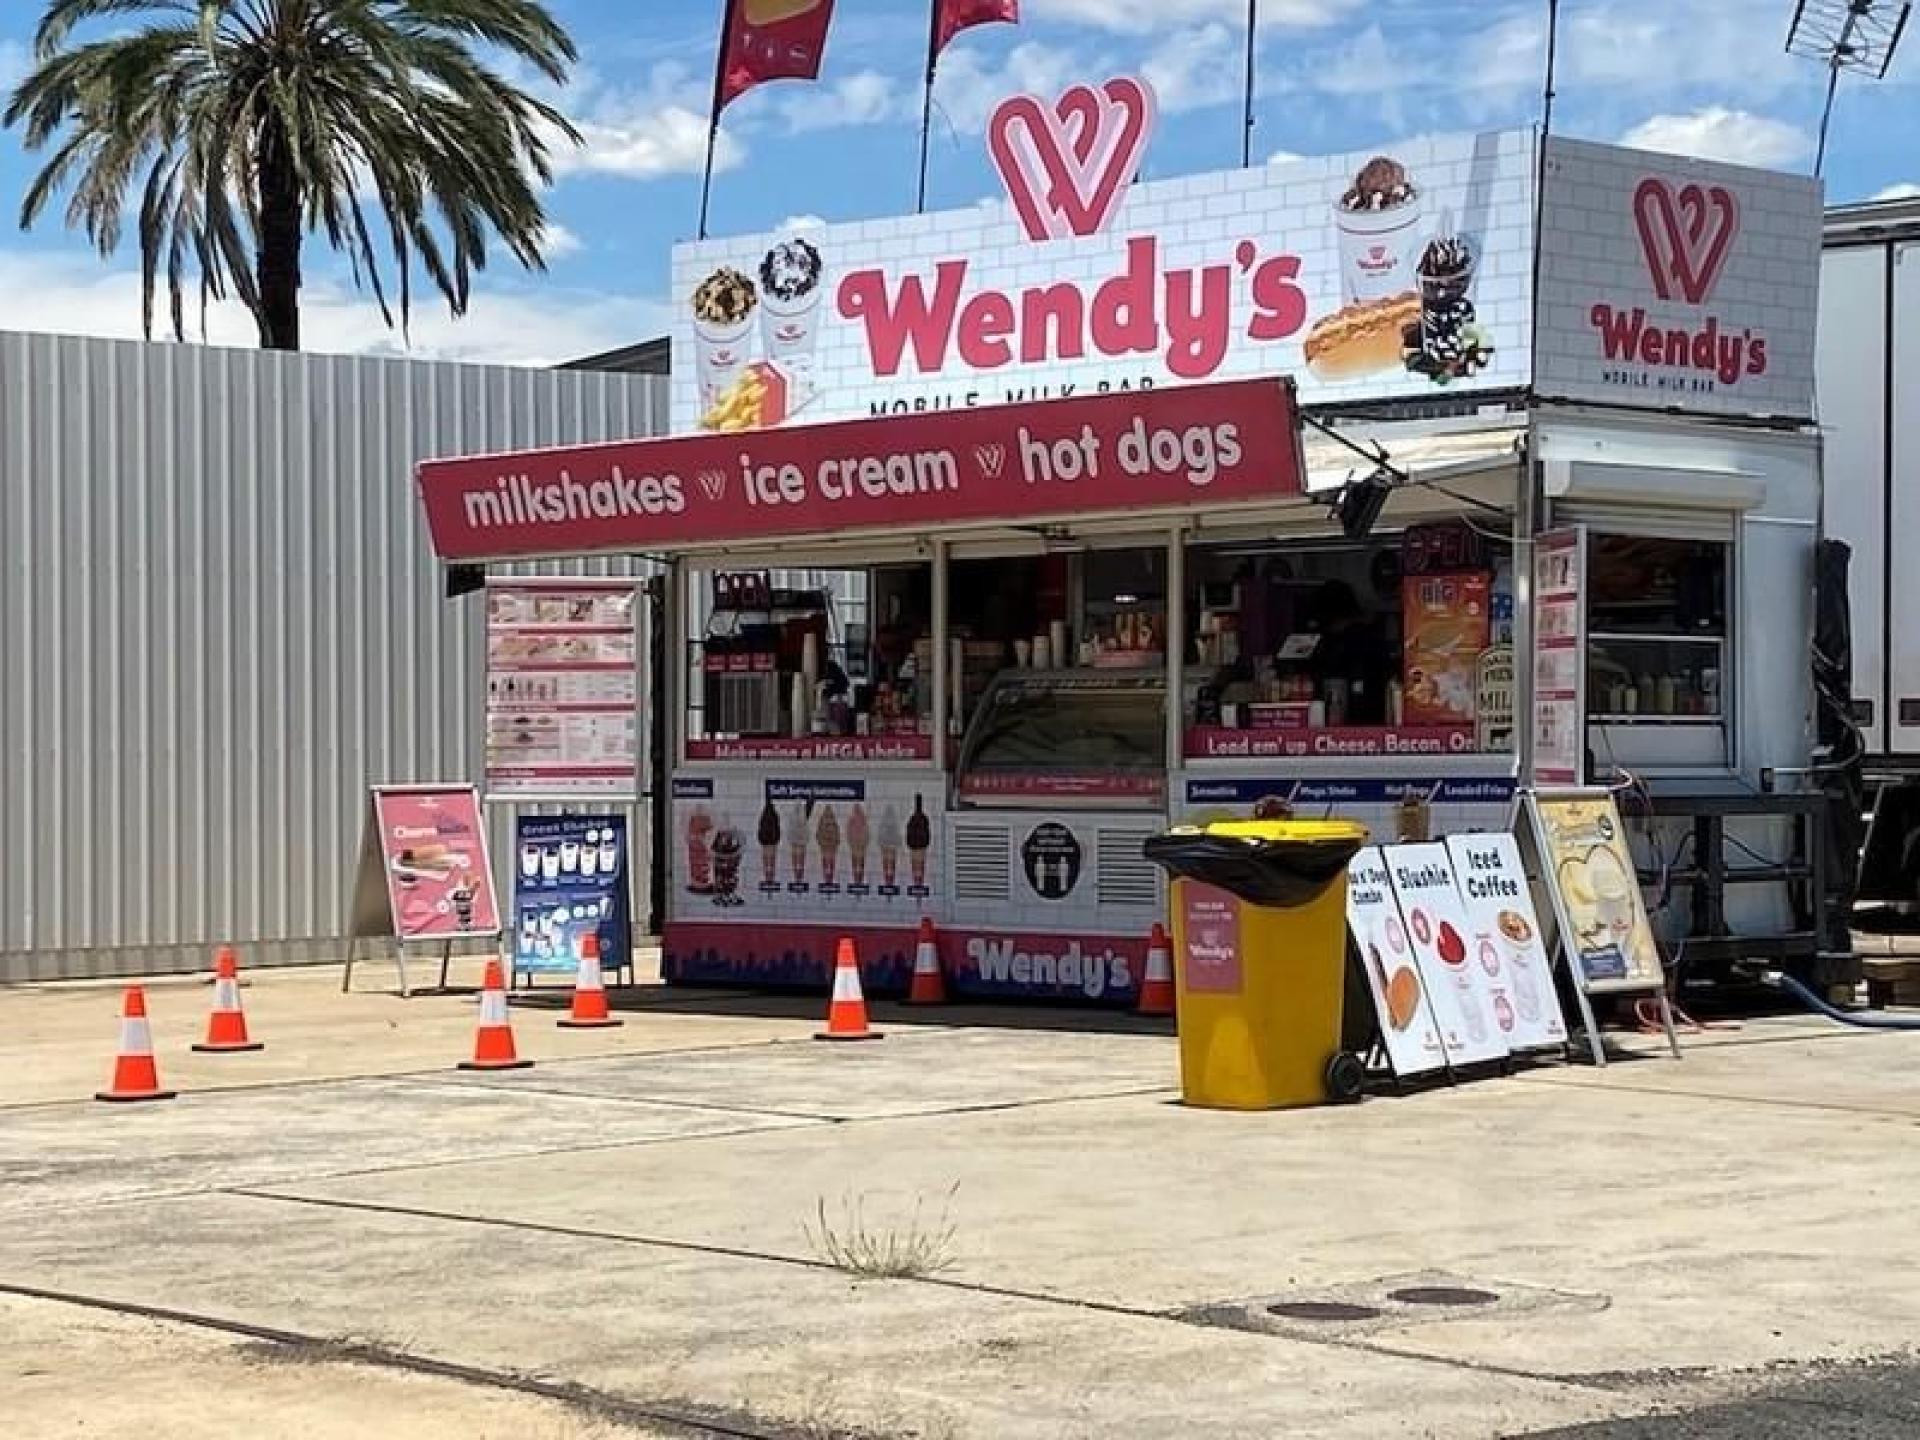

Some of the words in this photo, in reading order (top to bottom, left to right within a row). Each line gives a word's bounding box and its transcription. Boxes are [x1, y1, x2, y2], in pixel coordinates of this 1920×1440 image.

[837, 236, 1307, 378] Wendy's
[1590, 304, 1768, 385] Wendy's
[462, 466, 686, 528] milkshakes
[740, 453, 806, 505] ice
[817, 447, 959, 501] cream
[1018, 423, 1100, 484] hot
[1117, 415, 1242, 485] dogs
[816, 743, 862, 758] MEGA
[1208, 736, 1248, 755] Load
[1286, 741, 1307, 755] up
[1466, 847, 1503, 870] Iced
[1468, 875, 1518, 898] Coffee
[966, 938, 1131, 997] Wendy's
